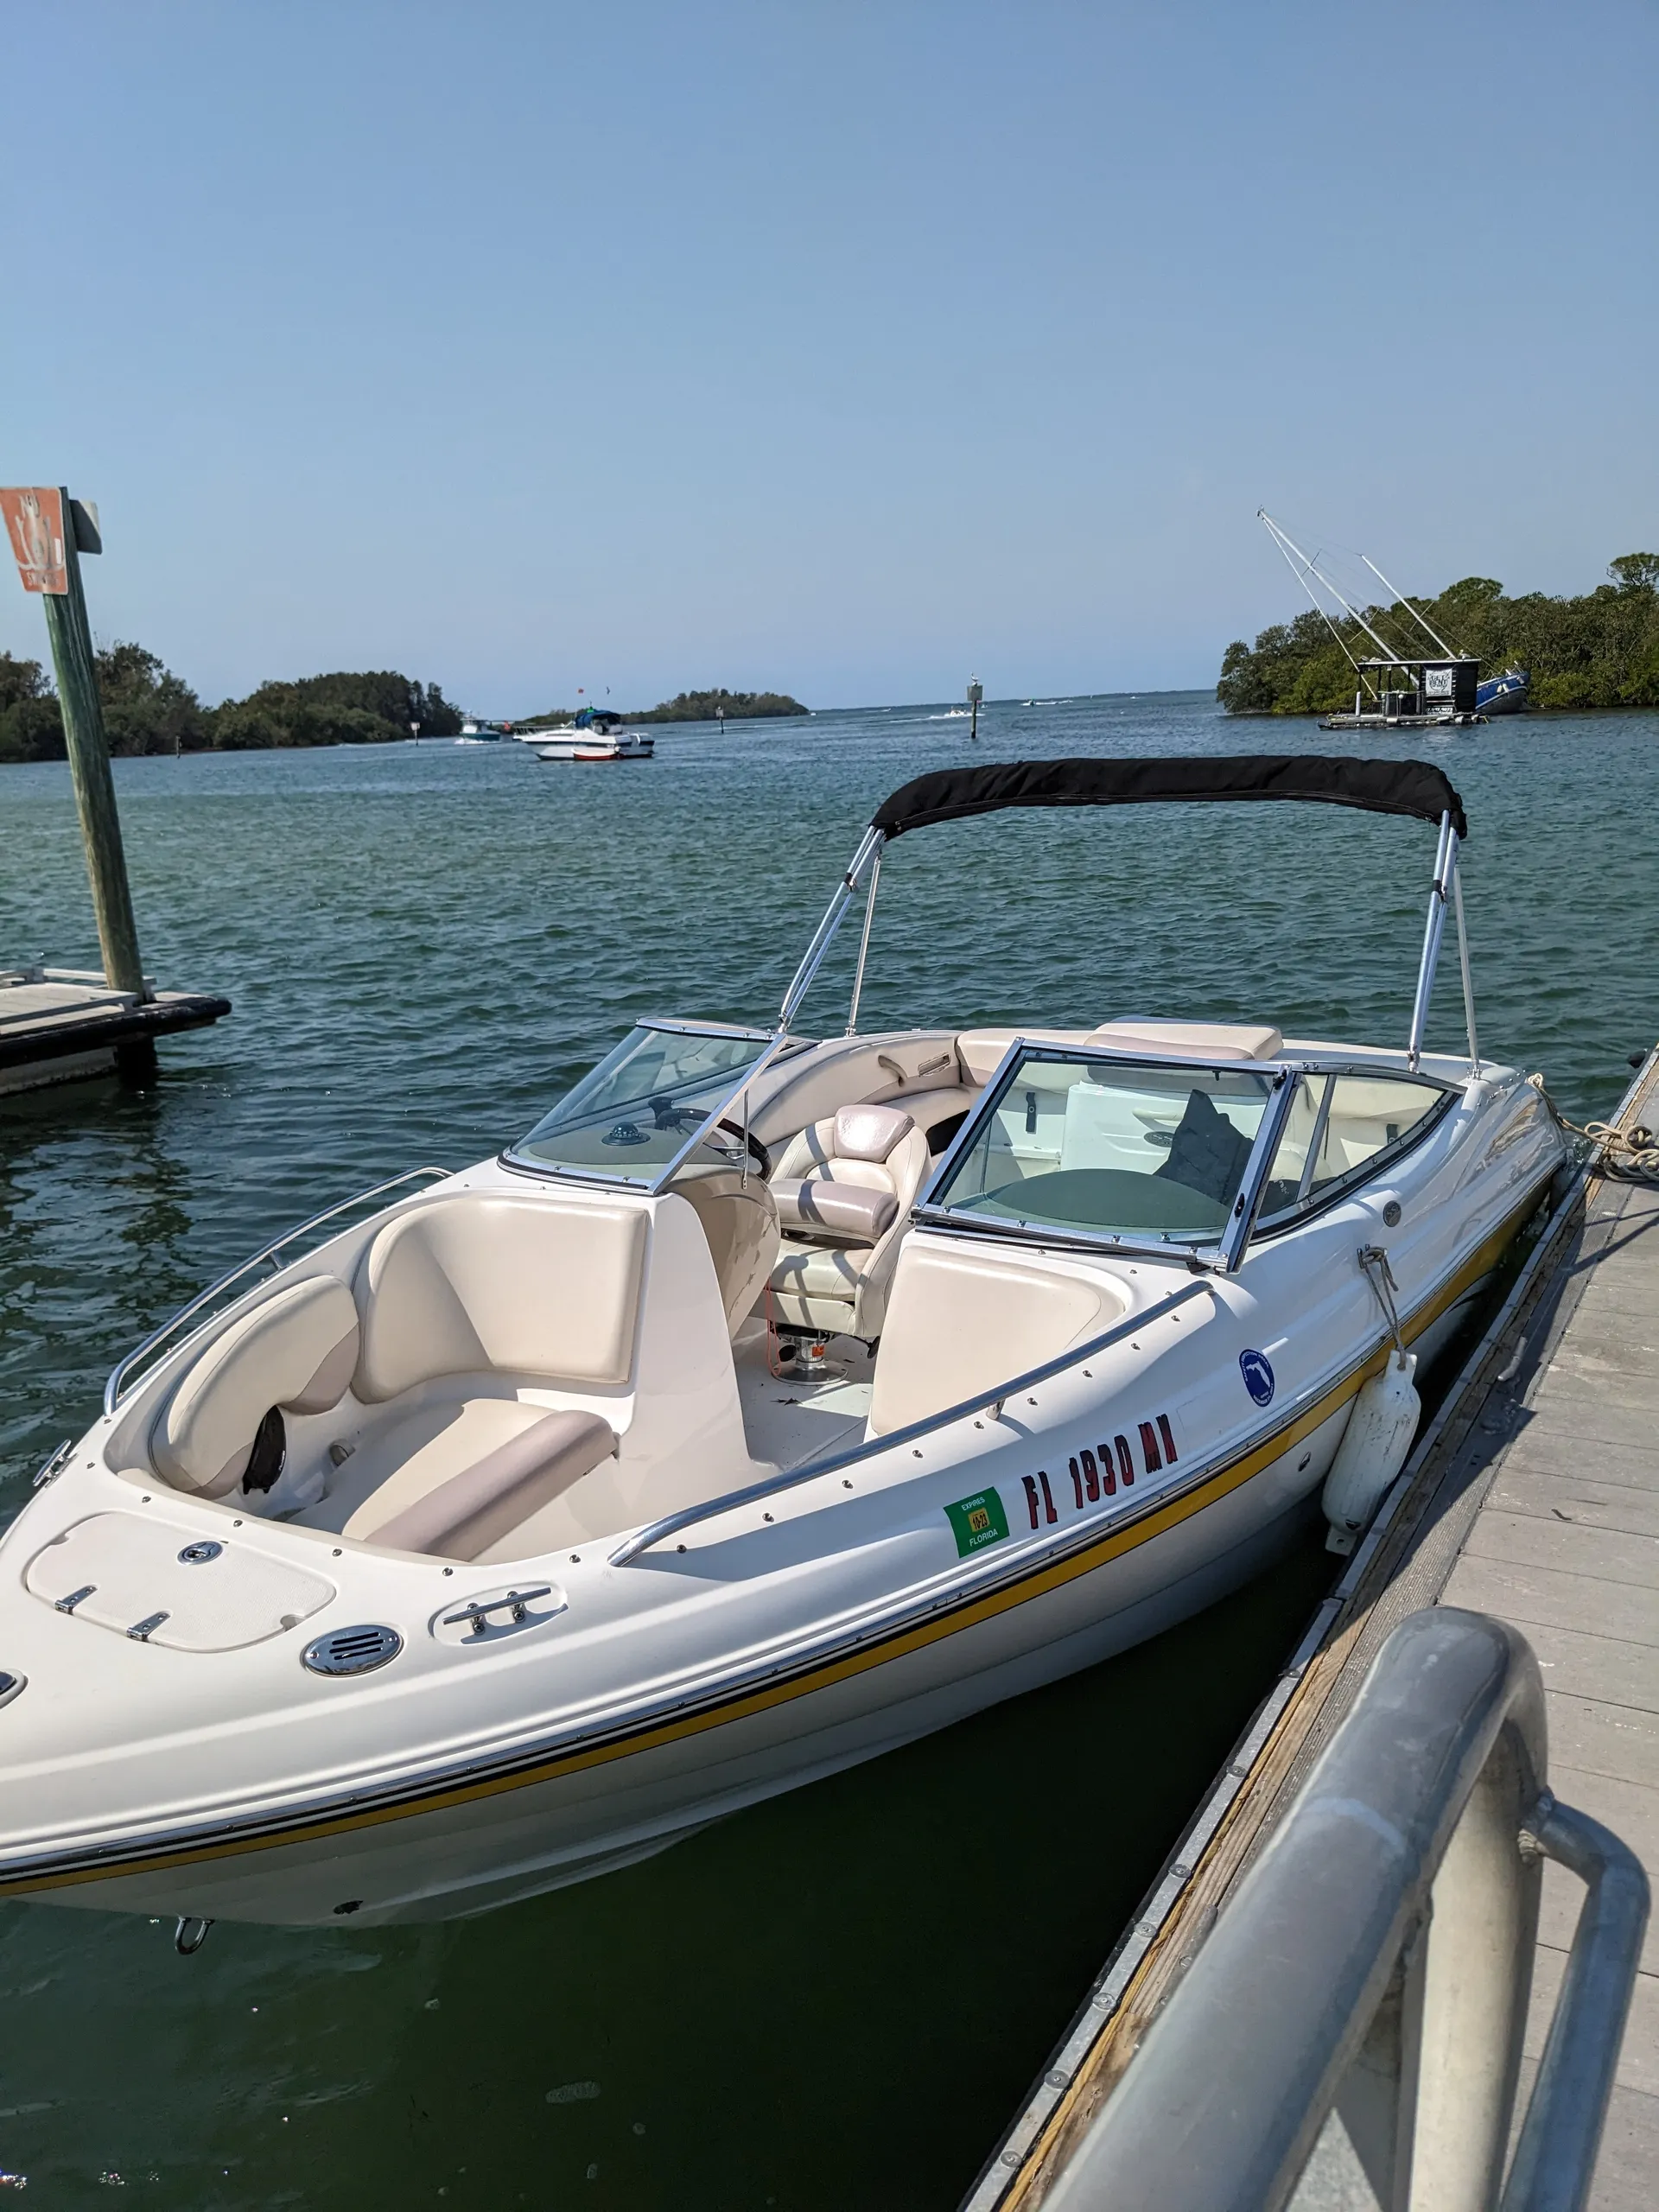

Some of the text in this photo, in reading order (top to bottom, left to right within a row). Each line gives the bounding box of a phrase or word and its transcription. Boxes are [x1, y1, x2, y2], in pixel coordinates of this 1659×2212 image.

[1021, 1471, 1058, 1529] FL
[1069, 1434, 1135, 1510] 1930
[961, 1497, 986, 1511] EXPIRES
[969, 1528, 998, 1547] FLORIDA
